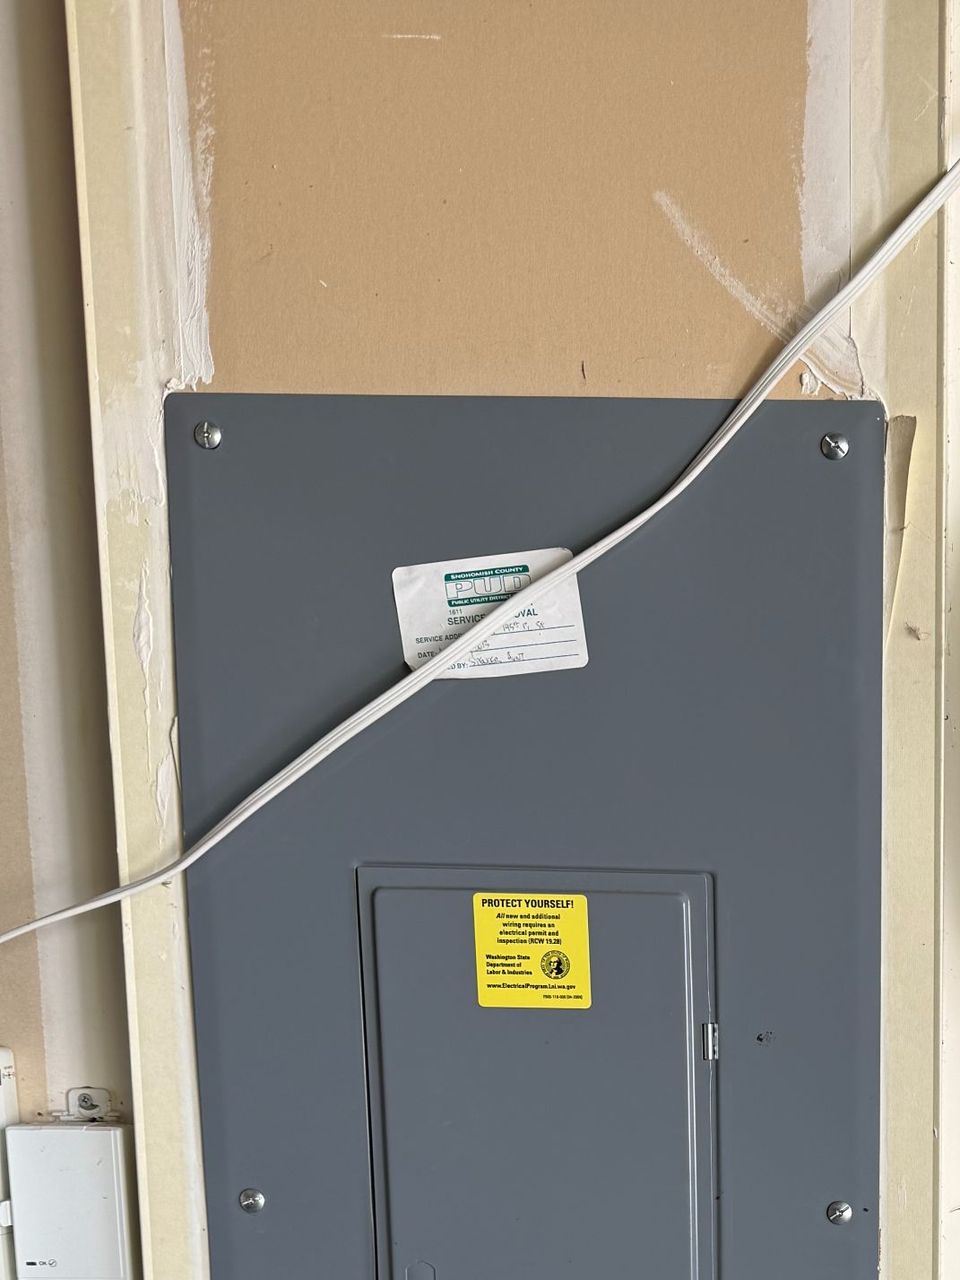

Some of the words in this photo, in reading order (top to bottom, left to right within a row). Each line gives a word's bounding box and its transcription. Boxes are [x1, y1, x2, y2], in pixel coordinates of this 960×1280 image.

[451, 569, 493, 580] SNOHOMISH
[494, 566, 524, 575] COUNTY
[445, 574, 531, 600] PUD
[447, 613, 486, 625] SERVICE
[415, 635, 443, 645] SERVICE
[481, 898, 523, 908] PROTECT
[524, 899, 574, 909] YOURSELF!
[502, 921, 522, 929] wiring
[522, 921, 547, 929] requires
